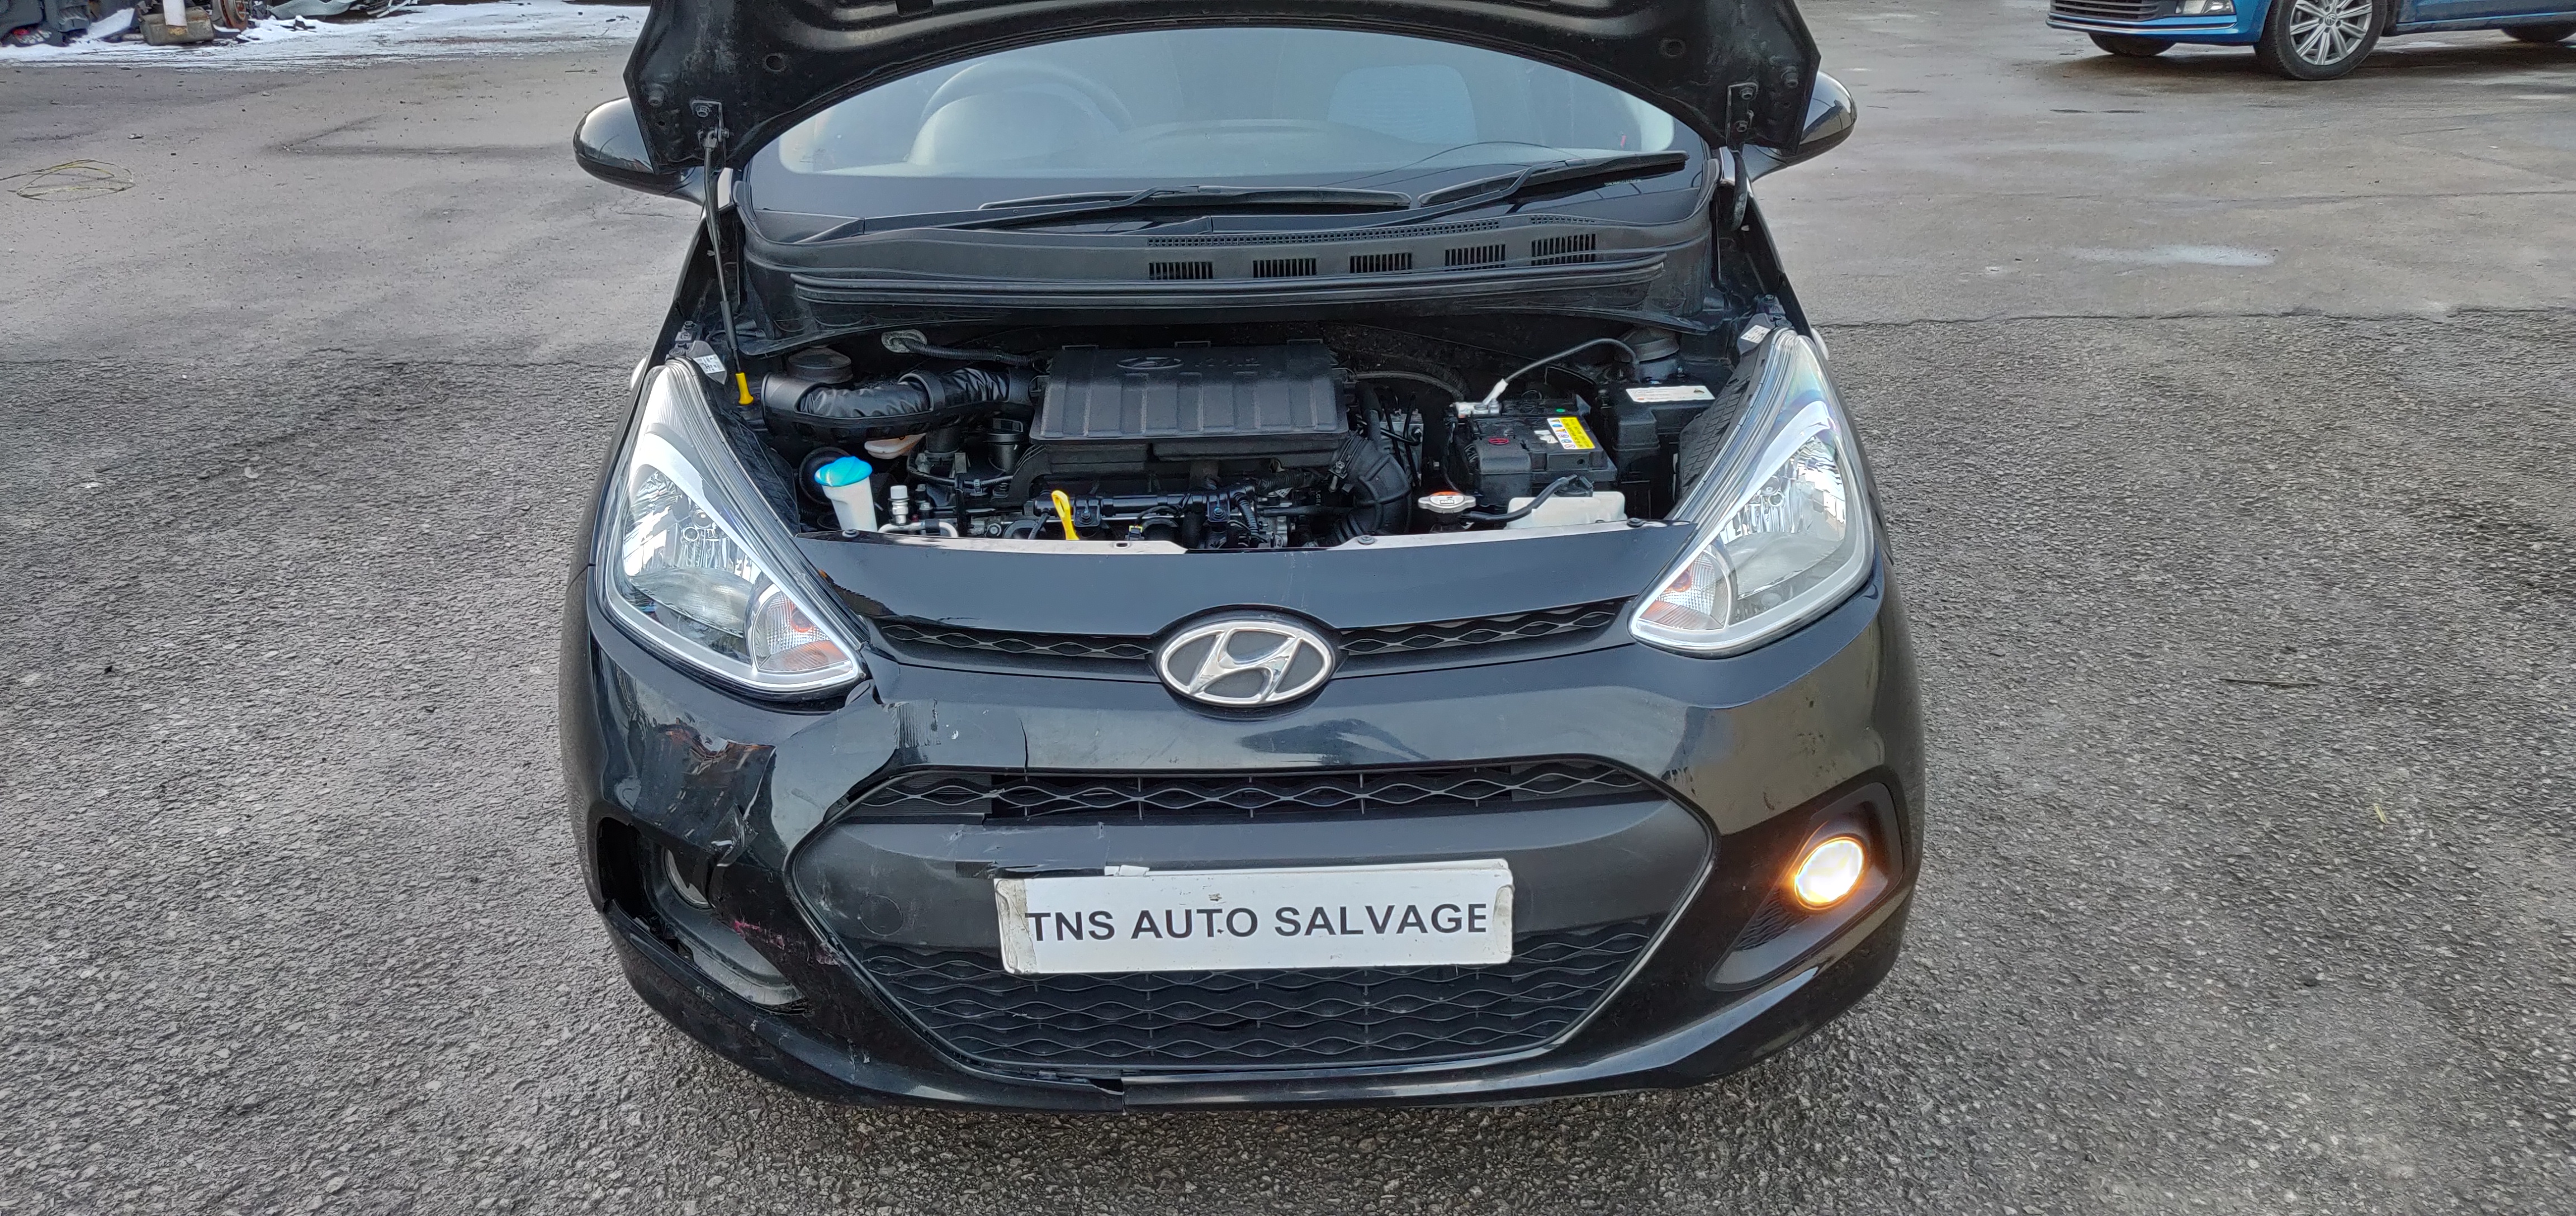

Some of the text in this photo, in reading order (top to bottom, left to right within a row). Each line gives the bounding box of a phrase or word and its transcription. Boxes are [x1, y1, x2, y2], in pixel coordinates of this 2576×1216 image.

[1025, 903, 1487, 941] TNS AUTO SALVAGE
